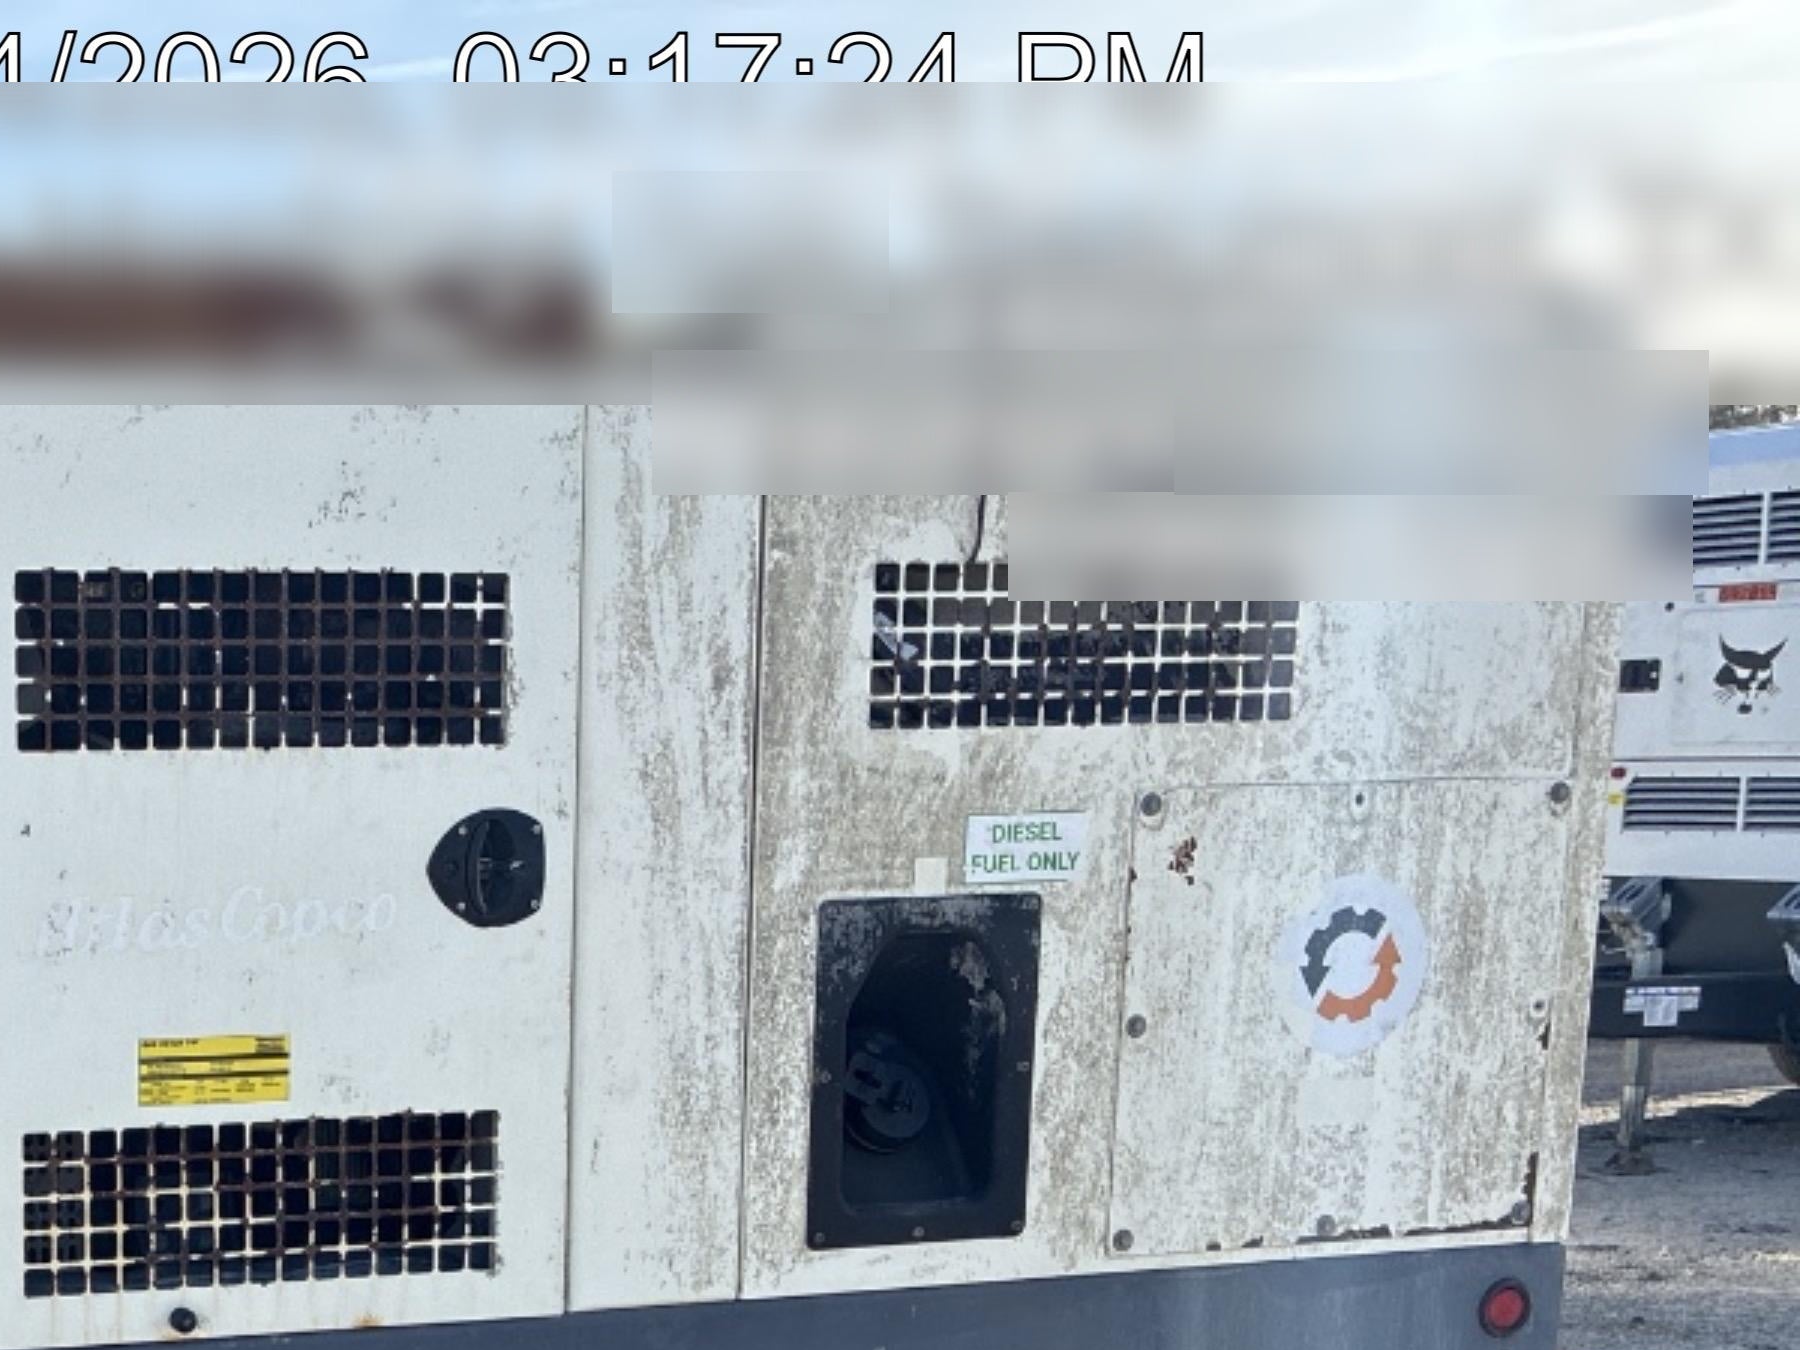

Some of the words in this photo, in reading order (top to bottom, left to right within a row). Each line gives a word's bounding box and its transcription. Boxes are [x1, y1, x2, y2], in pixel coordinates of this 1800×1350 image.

[992, 821, 1063, 843] DIESEL
[971, 853, 1021, 873] FUEL
[1027, 851, 1080, 870] ONLY
